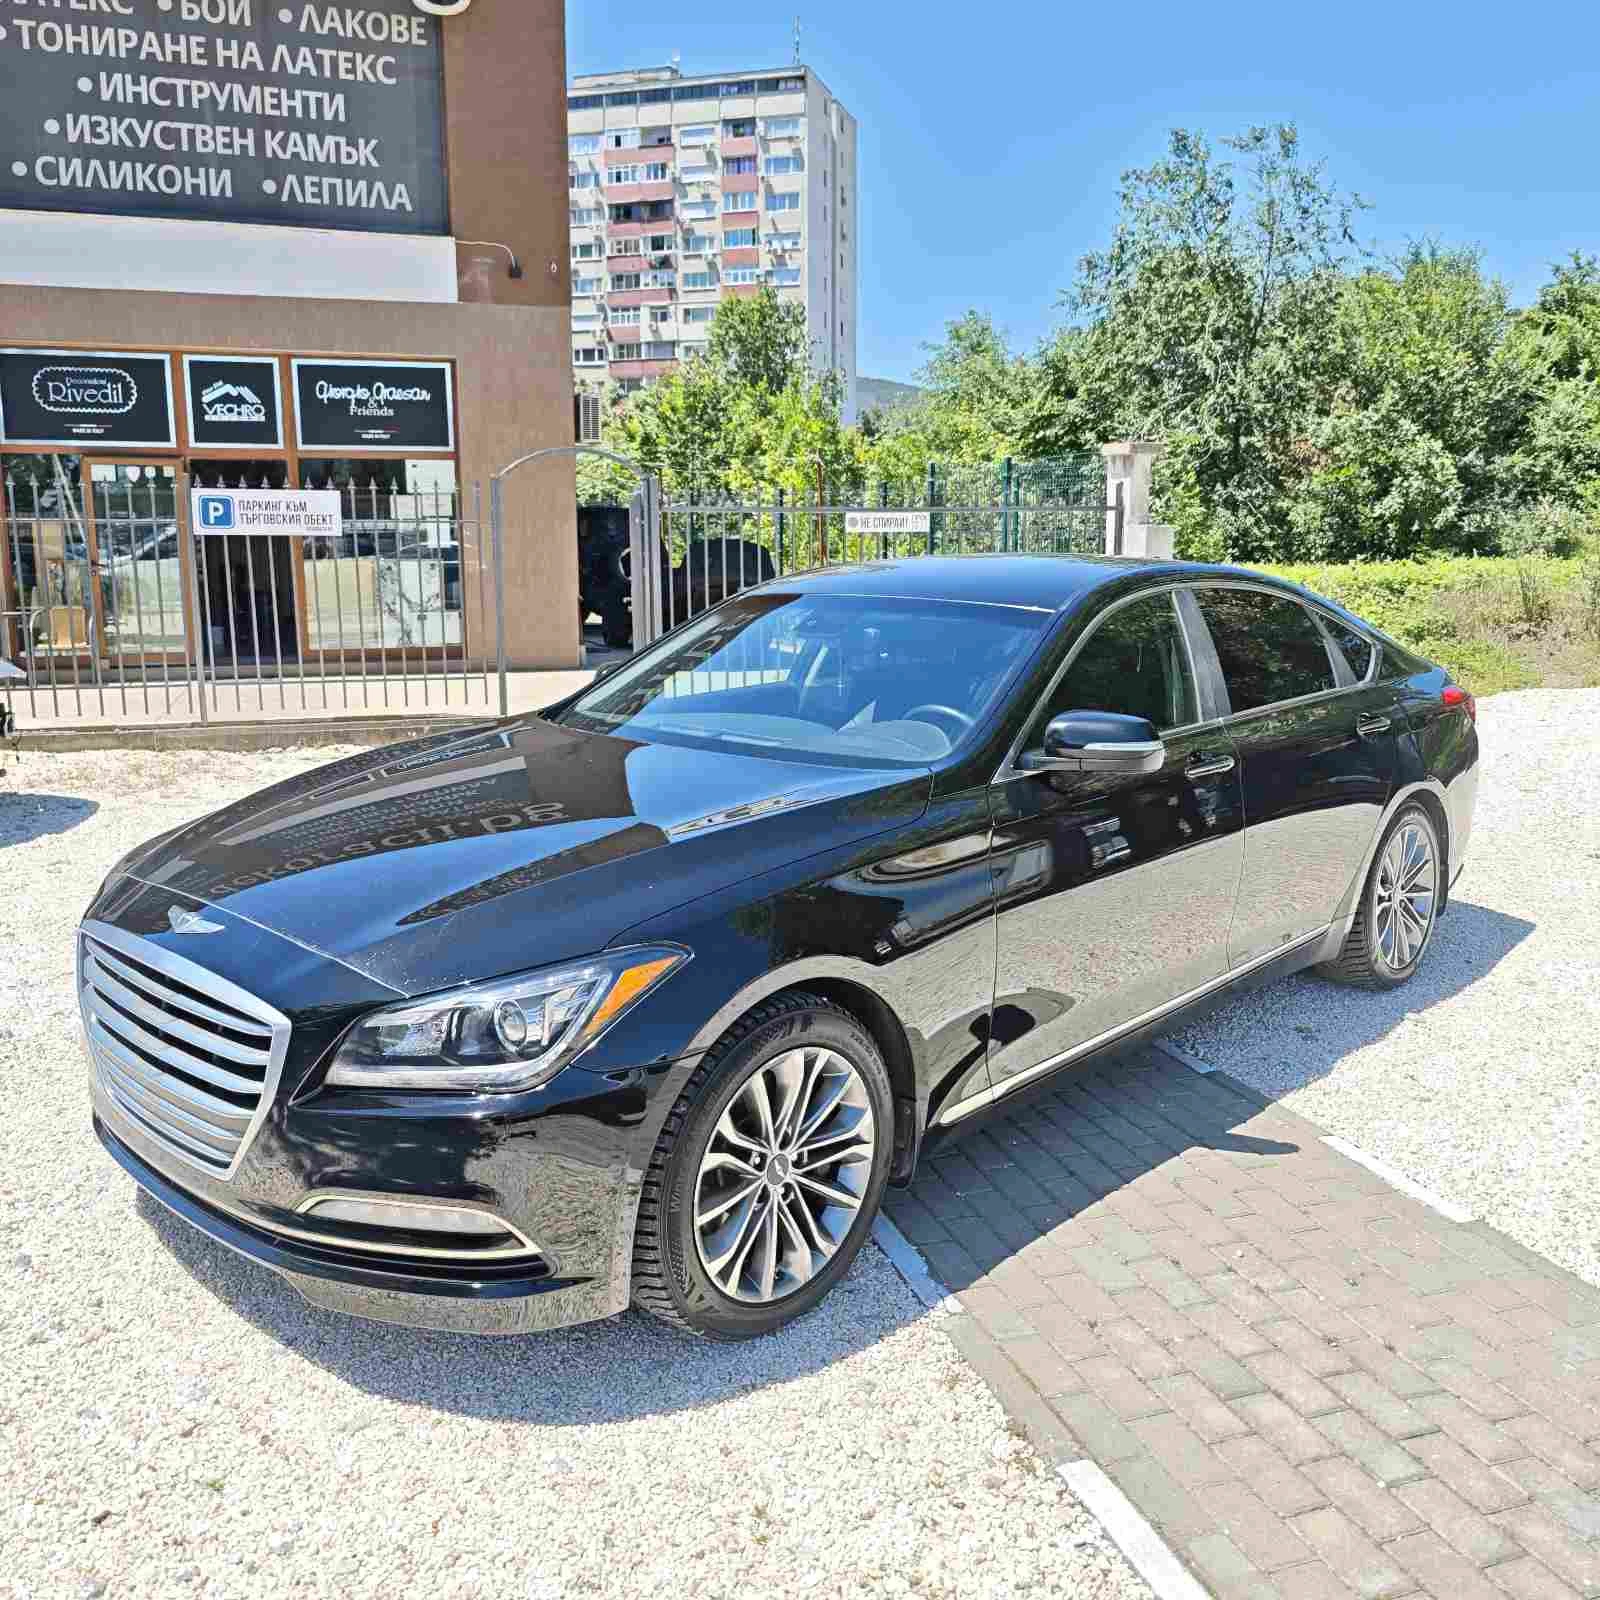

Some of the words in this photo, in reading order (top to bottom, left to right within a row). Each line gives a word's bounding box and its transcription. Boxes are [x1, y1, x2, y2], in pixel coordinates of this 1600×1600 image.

[299, 4, 428, 46] ЛАКОВЕ
[12, 18, 208, 66] ТОНИРАНЕ
[215, 38, 264, 72] НА
[271, 44, 397, 85] ЛАТЕКС
[99, 71, 346, 122] ИНСТРУМЕНТИ
[65, 113, 256, 157] ИЗКУСТВЕН
[264, 129, 381, 168] КАМЪК
[34, 155, 233, 198] СИЛИКОНИ
[281, 174, 413, 212] ЛЕПИЛА
[47, 382, 124, 403] Rivedil
[202, 403, 265, 417] VECHRO
[350, 406, 395, 416] Friends
[208, 502, 224, 524] P
[239, 500, 283, 512] ПАРКИНГ
[286, 501, 307, 512] КЪМ
[239, 513, 301, 525] ТЪРГОВСКИЯ
[304, 514, 333, 525] ОБЕКТ
